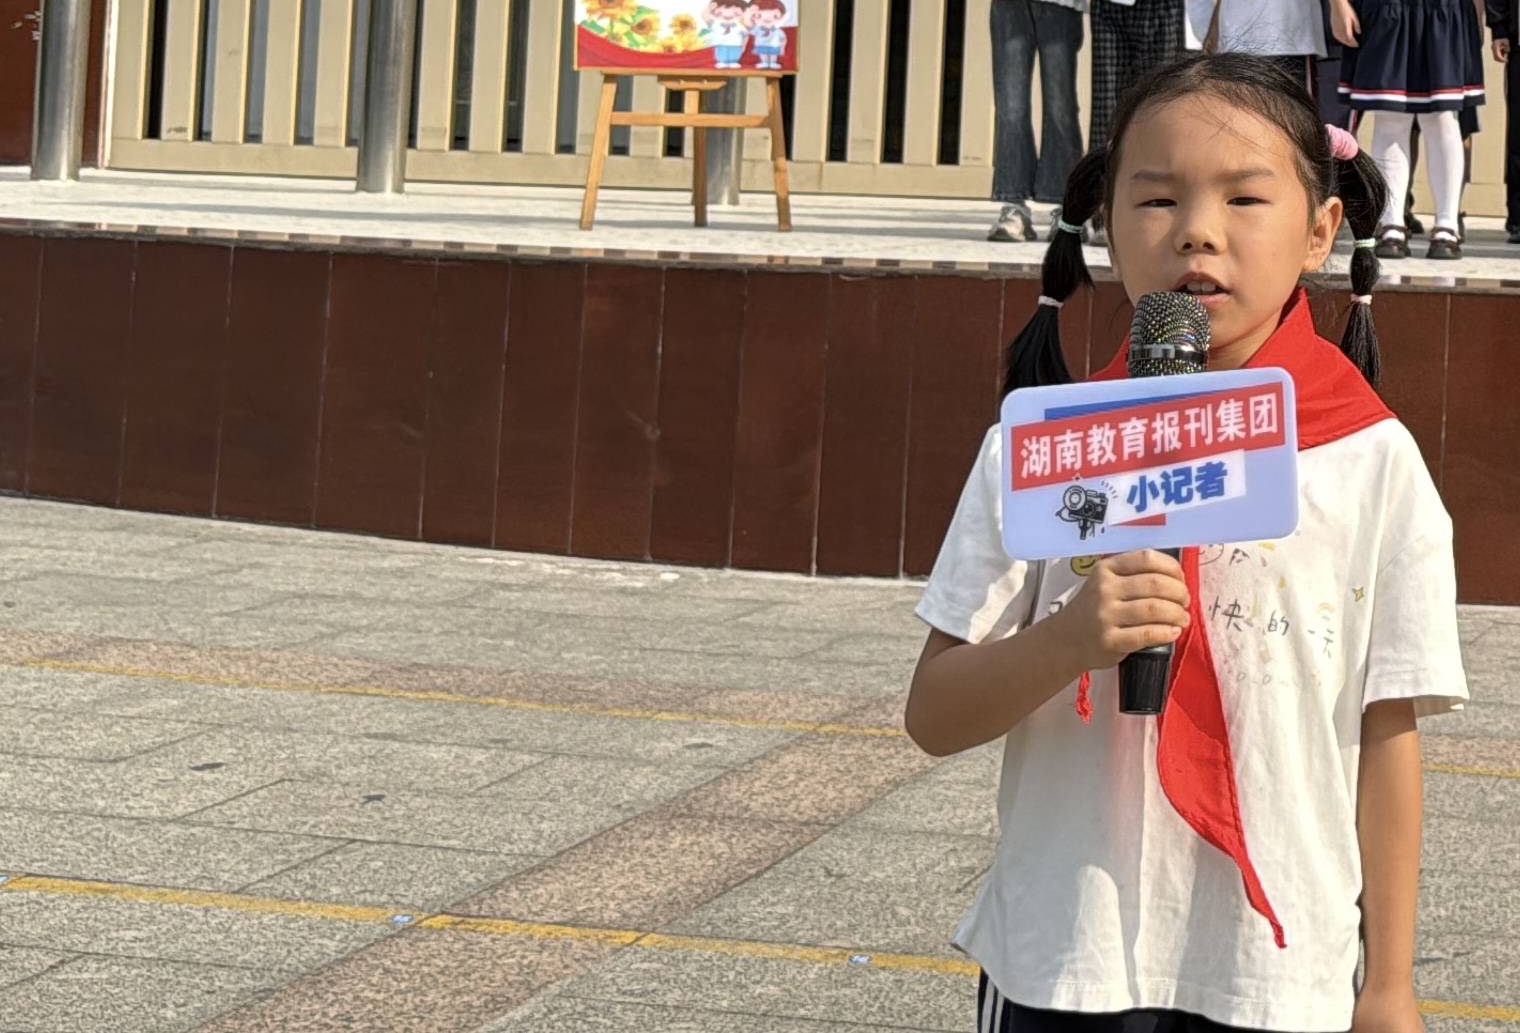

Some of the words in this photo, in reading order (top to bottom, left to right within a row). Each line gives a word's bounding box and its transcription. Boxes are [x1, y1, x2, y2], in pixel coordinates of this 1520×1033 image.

[1020, 392, 1278, 480] 湖南教育报刊集团
[1127, 461, 1228, 514] 小记者
